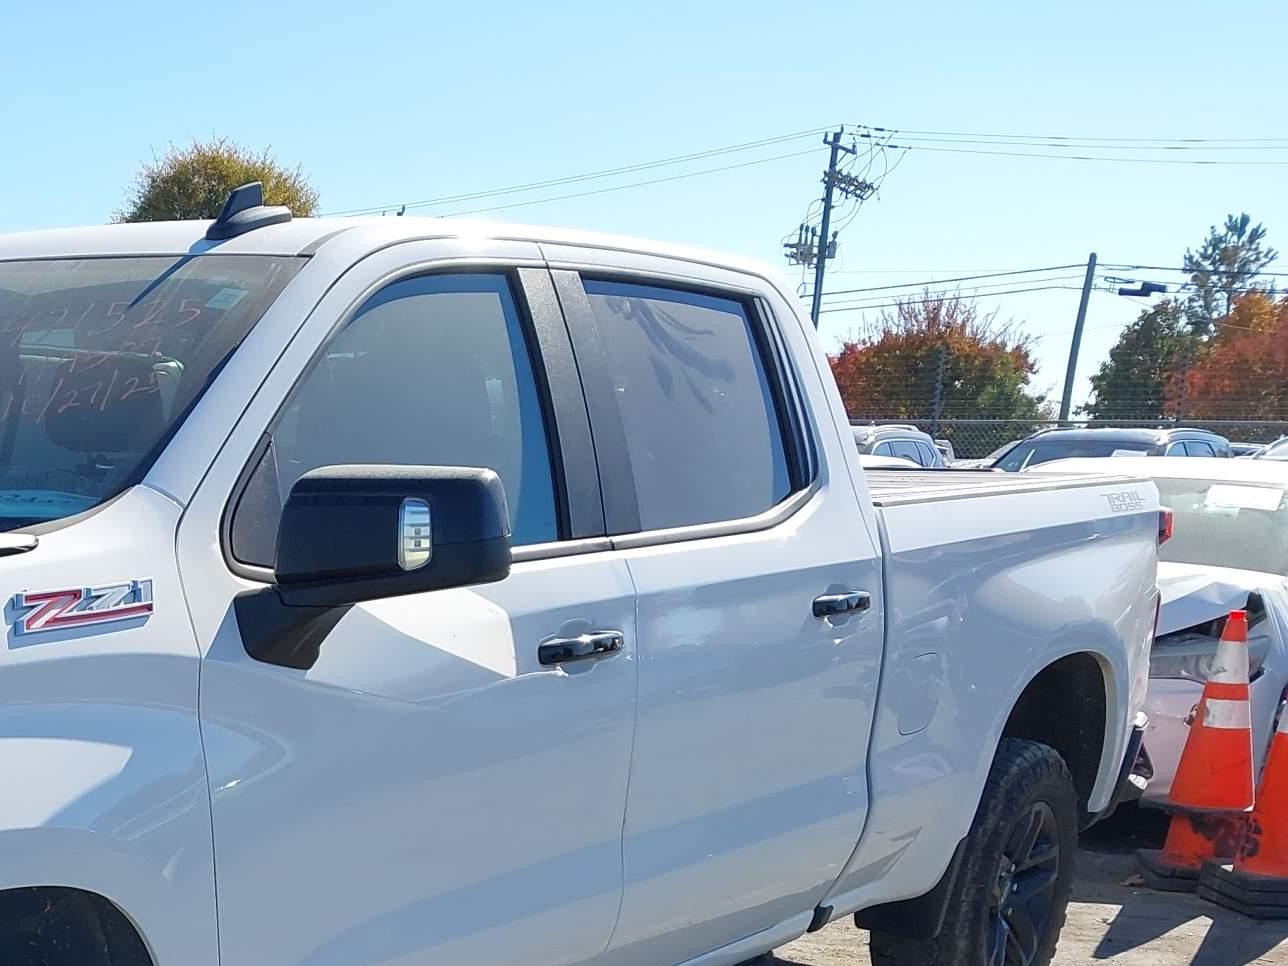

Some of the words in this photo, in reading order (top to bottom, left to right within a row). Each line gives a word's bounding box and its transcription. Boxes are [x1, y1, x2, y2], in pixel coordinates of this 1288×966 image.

[1100, 490, 1146, 504] TRAIL
[1111, 501, 1144, 513] BOSS
[18, 577, 154, 632] Z71
